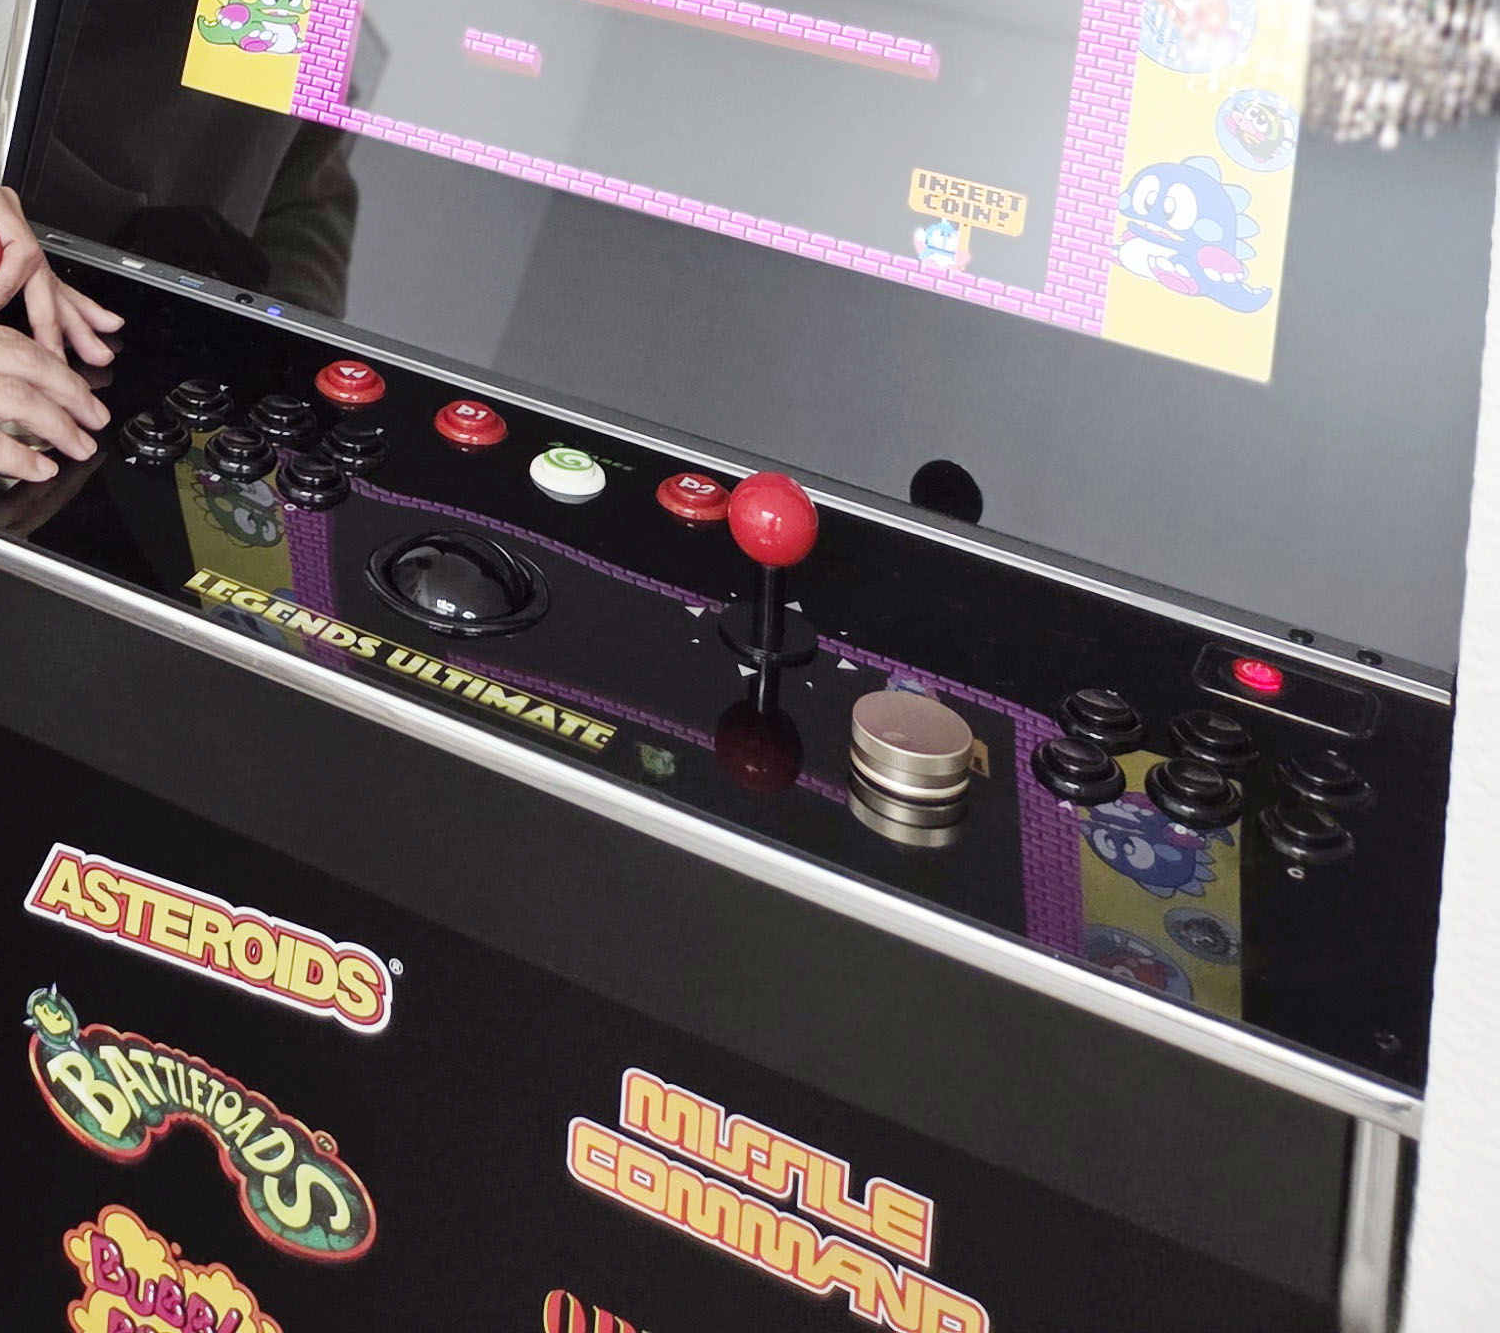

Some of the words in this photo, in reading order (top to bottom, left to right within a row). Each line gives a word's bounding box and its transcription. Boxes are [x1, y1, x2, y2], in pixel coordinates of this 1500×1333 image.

[918, 172, 1023, 212] INSERT
[923, 193, 1010, 228] COIN!
[455, 404, 488, 421] P1
[678, 476, 717, 496] P2
[183, 569, 386, 660] LEGENDS
[386, 646, 616, 750] ULTIMATE
[30, 849, 387, 1025] ASTEROIDS
[46, 1044, 352, 1233] BATTLETOADS
[626, 1071, 928, 1259] MISSILE
